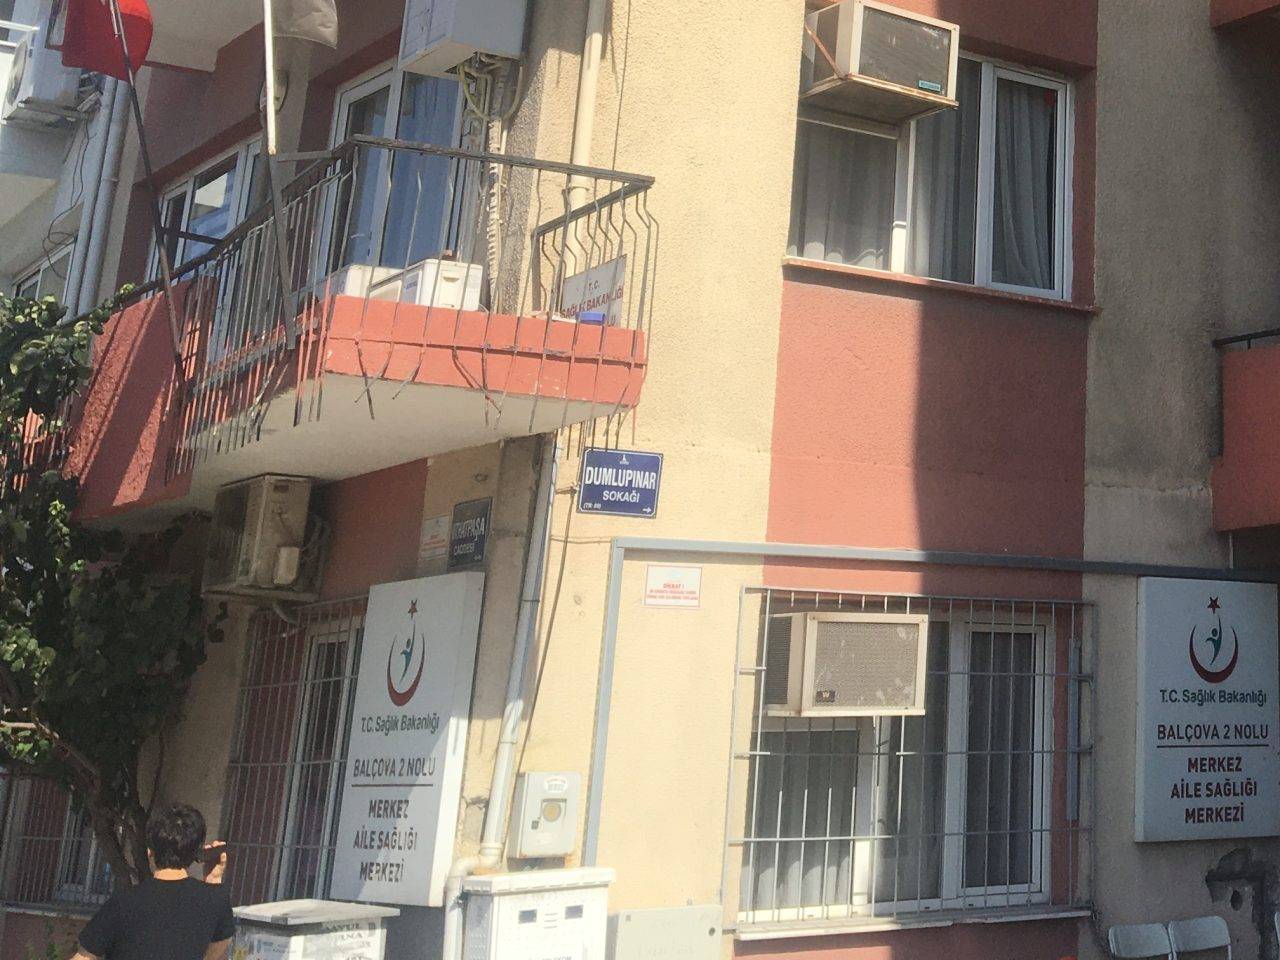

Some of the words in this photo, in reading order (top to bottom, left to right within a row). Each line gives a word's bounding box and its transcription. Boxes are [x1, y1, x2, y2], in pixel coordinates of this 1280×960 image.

[584, 466, 657, 490] DUMLUPINAR
[602, 490, 640, 503] SOKAĞI
[1160, 690, 1181, 703] T.C.
[1183, 689, 1216, 707] Sağlık
[1218, 689, 1267, 708] Bakanlığı
[361, 717, 374, 732] T.C.
[375, 715, 399, 736] Sağlık
[400, 712, 440, 734] Bakanlığı
[1157, 724, 1220, 742] BALÇOVA
[1223, 724, 1231, 739] 2
[1234, 724, 1269, 739] NOLU
[353, 758, 397, 779] BALÇOVA
[398, 758, 405, 777] 2
[406, 757, 436, 777] NOLU
[1187, 756, 1243, 773] MERKEZ
[1170, 778, 1202, 799] AİLE
[1205, 778, 1257, 798] SAĞLIĞI
[368, 799, 410, 819] MERKEZ
[1184, 801, 1245, 824] MERKEZİ
[352, 825, 377, 850] AİLE
[377, 826, 418, 851] SAĞLIĞI
[359, 858, 405, 882] MERKEZİ
